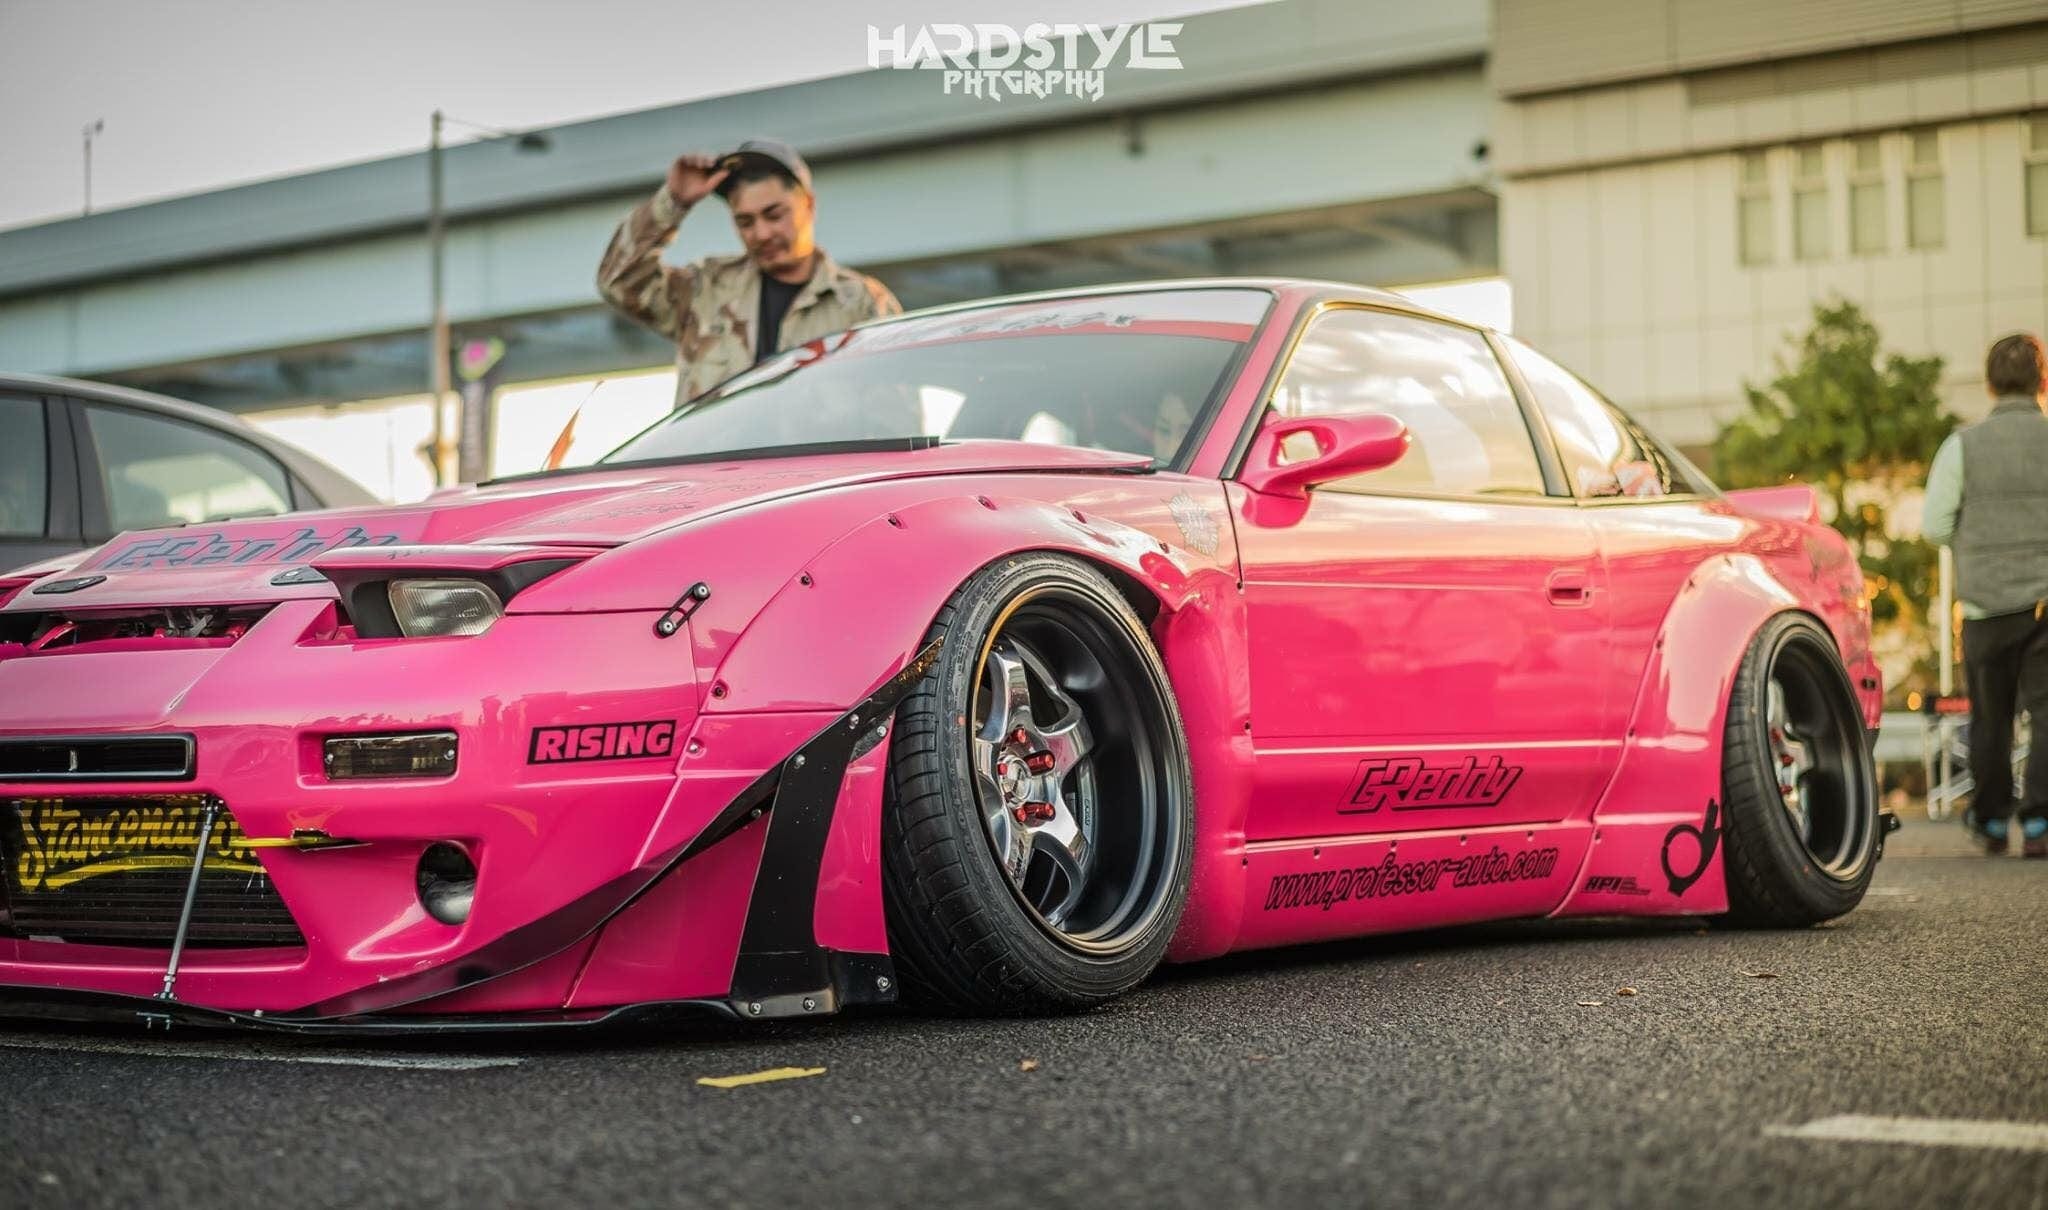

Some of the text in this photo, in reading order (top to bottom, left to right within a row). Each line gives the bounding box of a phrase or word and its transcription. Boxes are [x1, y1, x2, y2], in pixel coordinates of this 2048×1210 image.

[534, 723, 673, 762] RISING
[1336, 756, 1523, 814] GReddy
[18, 797, 258, 892] Stancenaton
[1264, 846, 1558, 911] www.professor-auto.com
